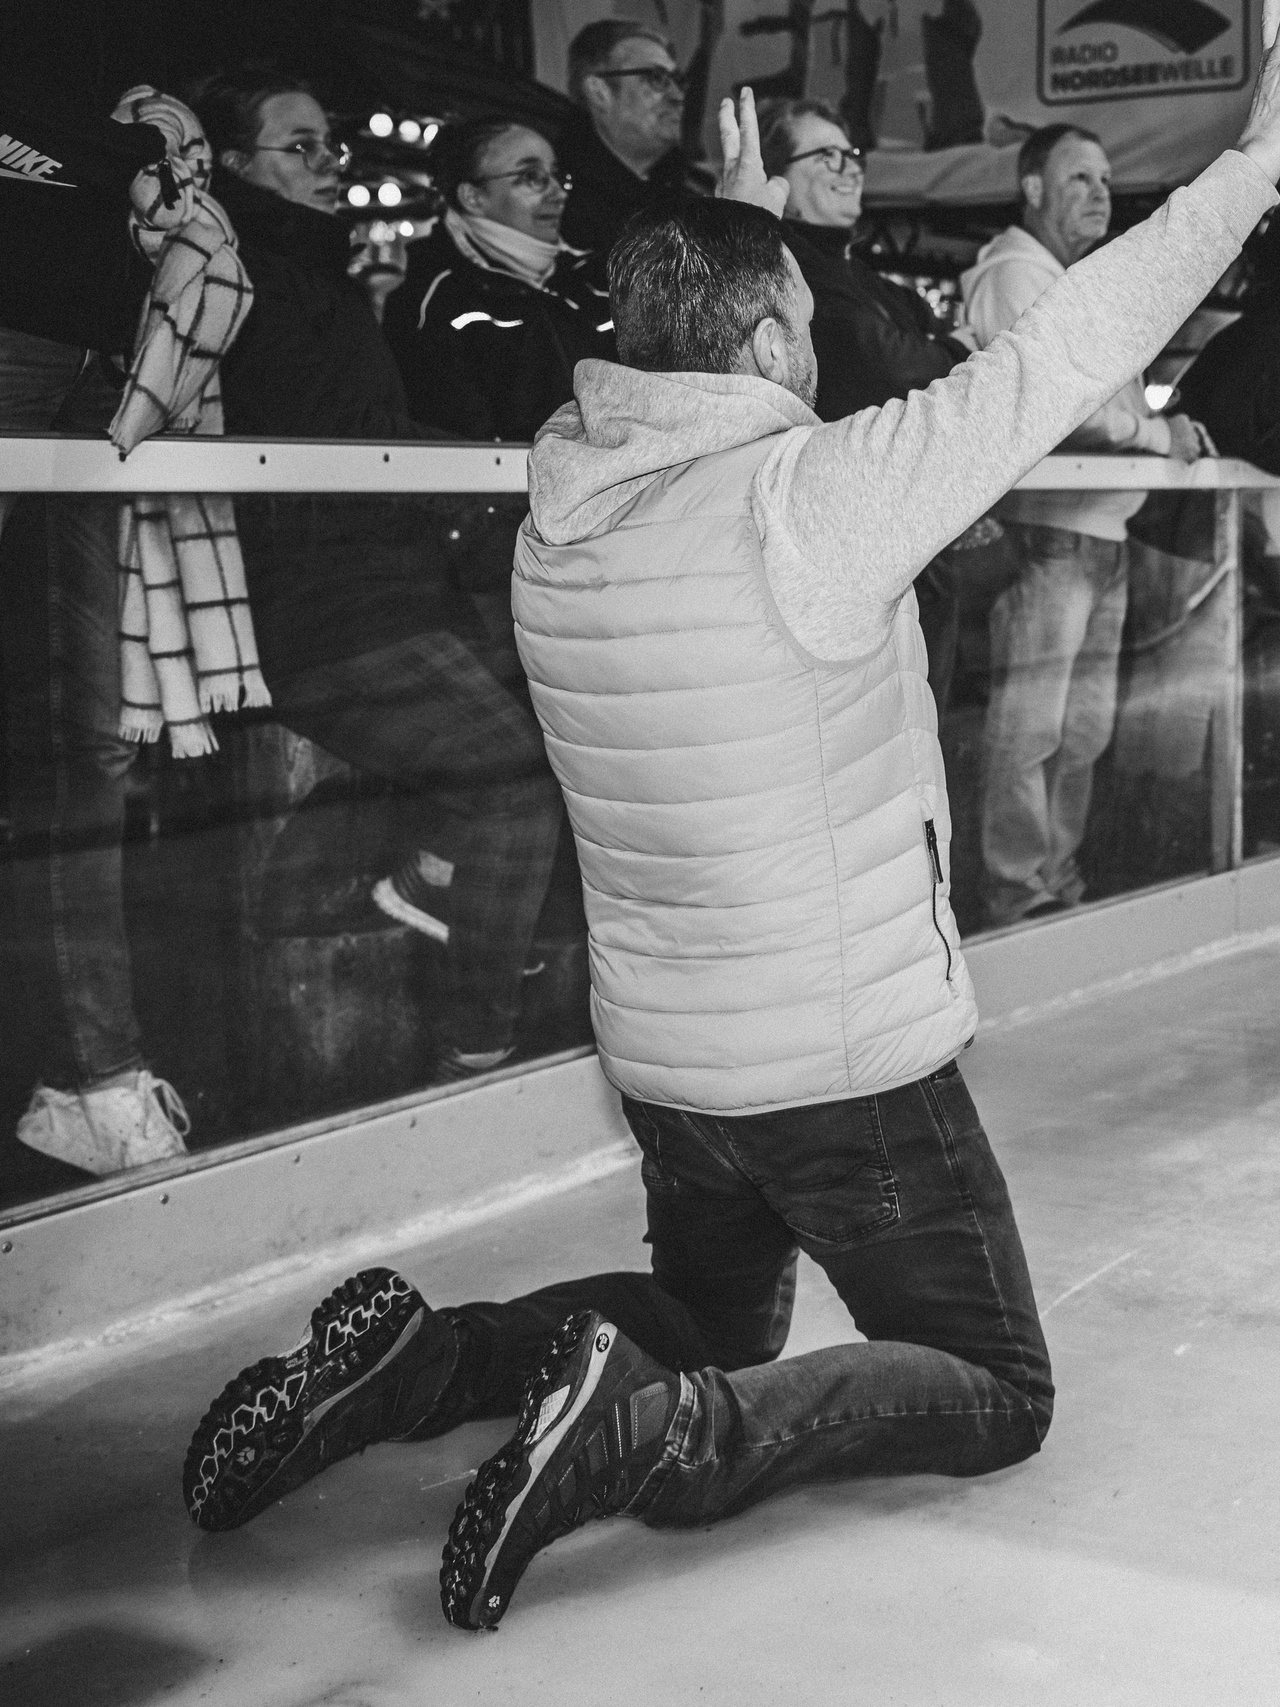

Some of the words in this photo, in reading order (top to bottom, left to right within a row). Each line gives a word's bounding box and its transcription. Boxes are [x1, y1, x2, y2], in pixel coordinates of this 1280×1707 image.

[1051, 41, 1119, 65] RADIO
[1050, 55, 1236, 94] NORDSEEWELLE
[0, 133, 63, 180] NIKE
